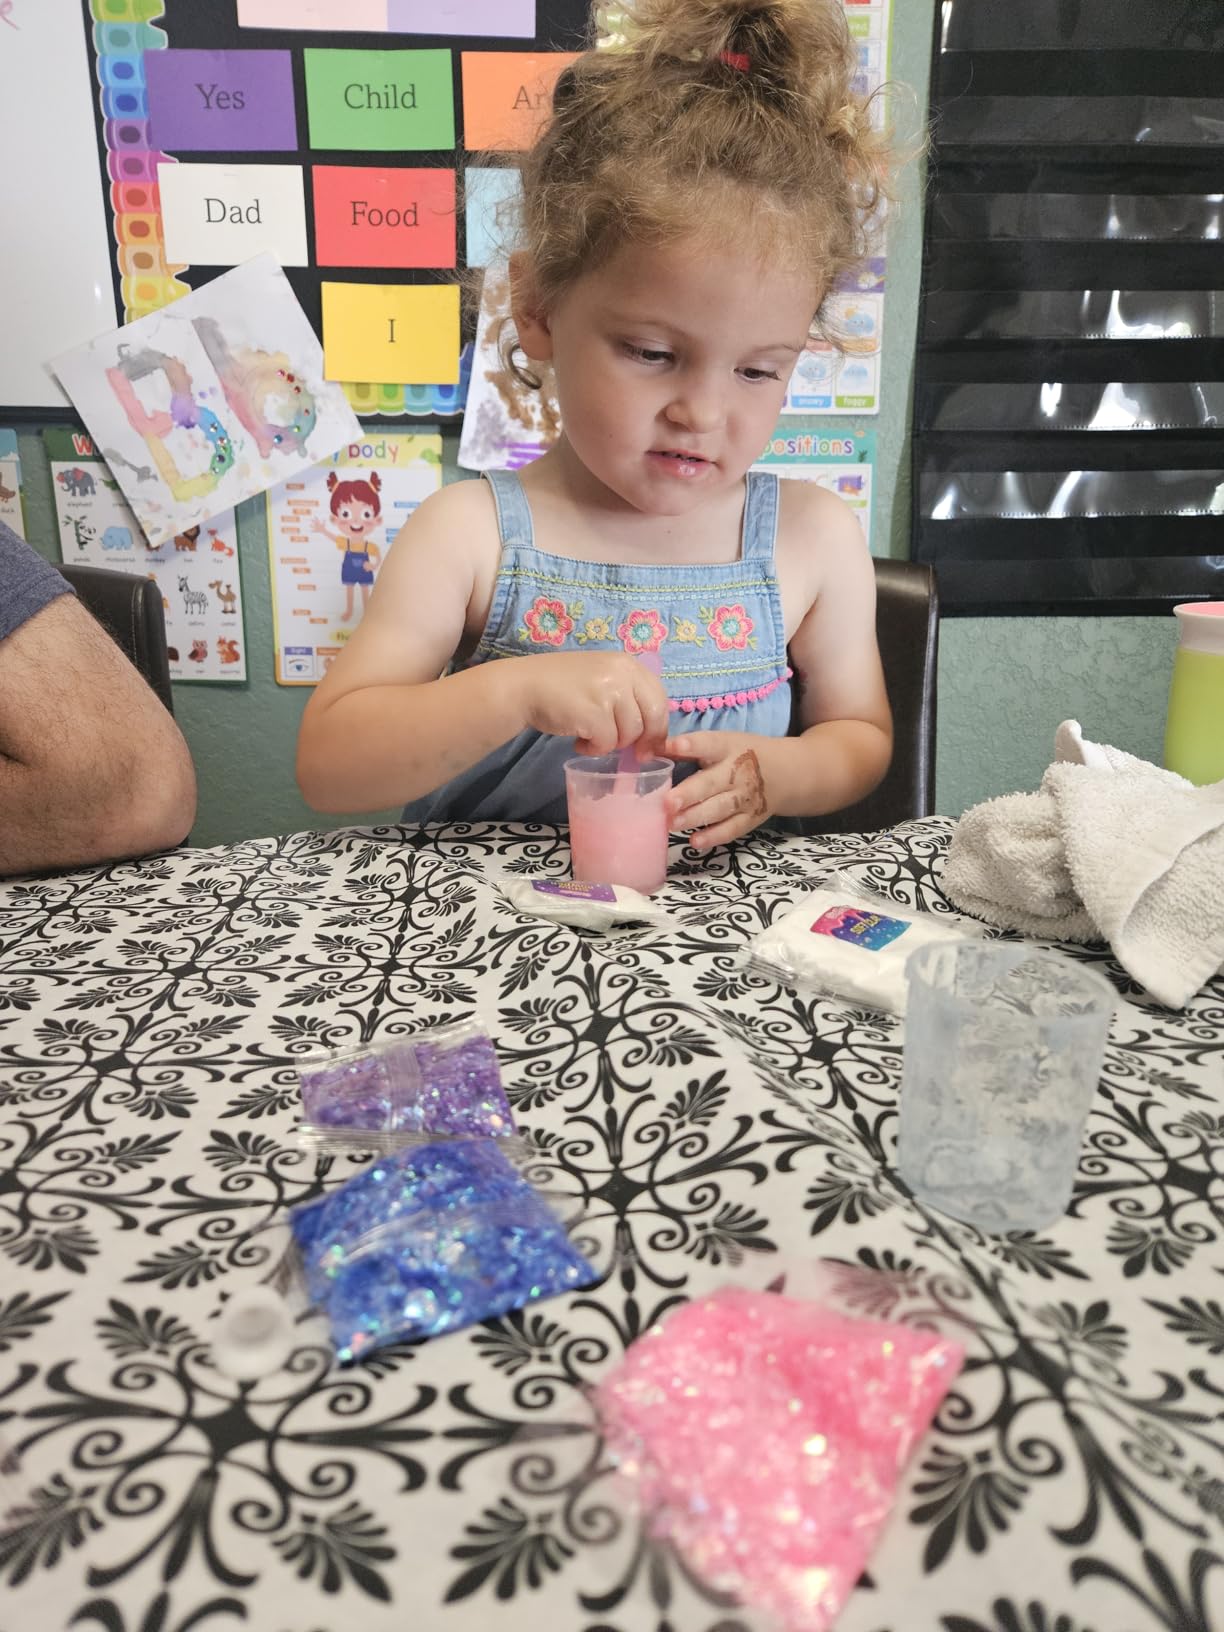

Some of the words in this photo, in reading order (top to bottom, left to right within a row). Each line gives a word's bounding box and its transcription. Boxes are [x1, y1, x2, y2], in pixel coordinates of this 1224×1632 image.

[195, 84, 245, 109] Yes
[344, 84, 418, 109] Child
[204, 198, 262, 224] Dad
[350, 201, 419, 227] Food
[388, 319, 395, 342] I
